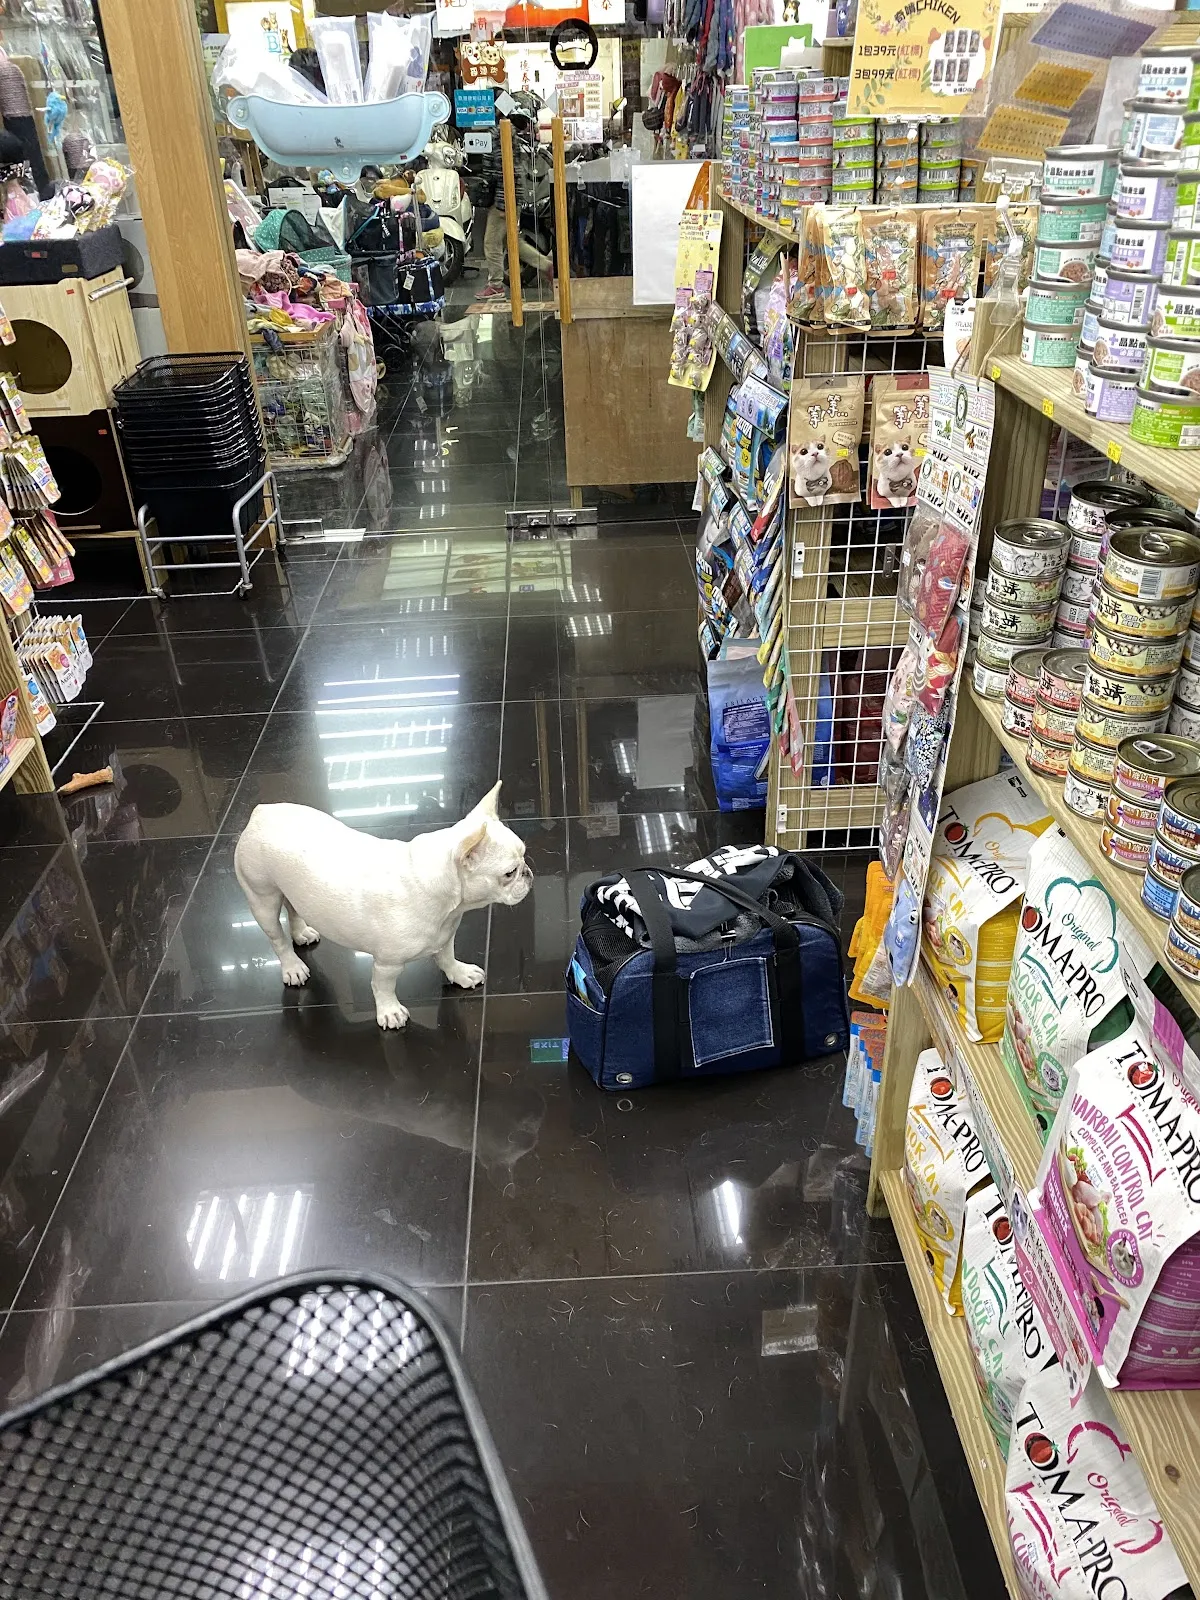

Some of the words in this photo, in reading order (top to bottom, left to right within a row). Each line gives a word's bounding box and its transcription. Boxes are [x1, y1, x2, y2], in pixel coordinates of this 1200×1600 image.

[475, 139, 488, 148] Pay
[1061, 912, 1102, 952] Original
[1077, 1127, 1106, 1163] COMPLETE
[1100, 1160, 1114, 1179] AND
[1109, 1177, 1129, 1226] BALANCED
[1112, 1137, 1145, 1212] CONTROL
[1135, 1196, 1154, 1241] CAT
